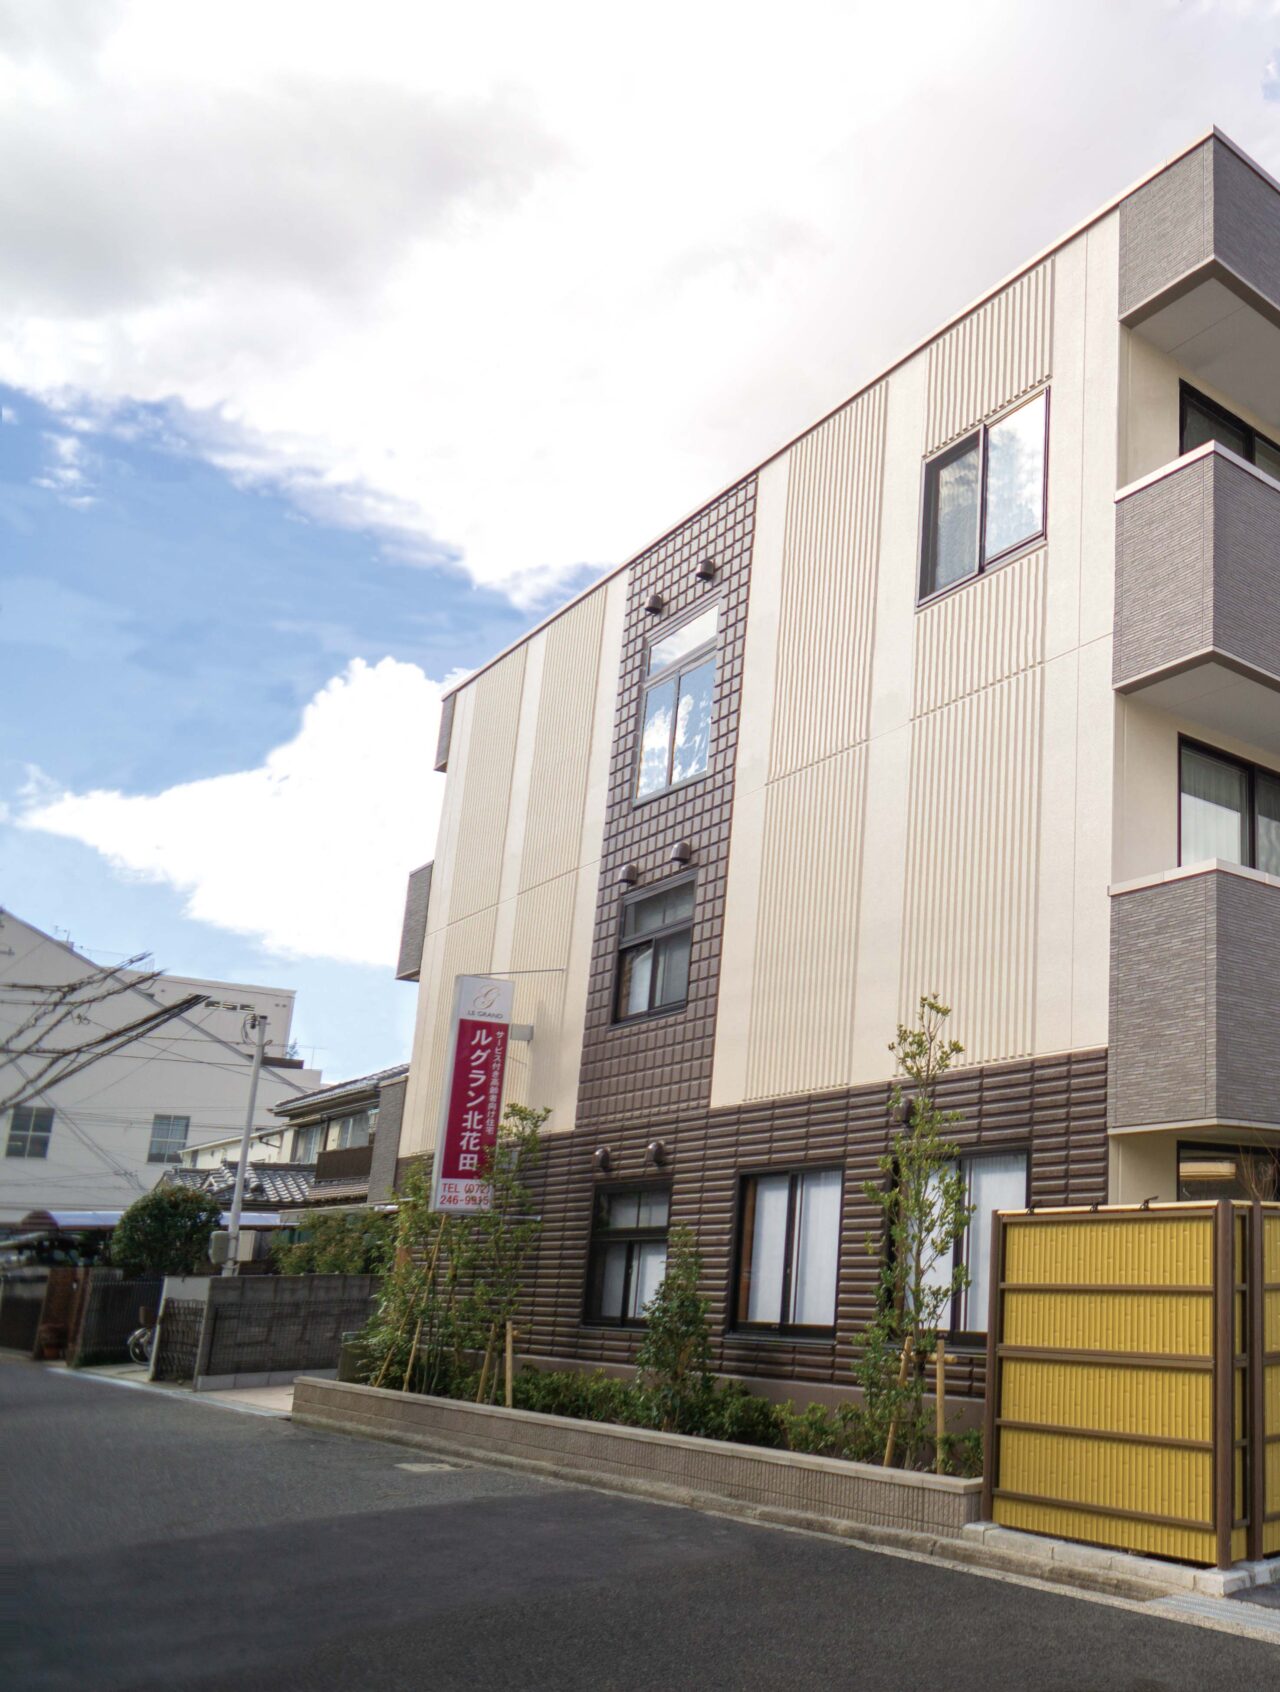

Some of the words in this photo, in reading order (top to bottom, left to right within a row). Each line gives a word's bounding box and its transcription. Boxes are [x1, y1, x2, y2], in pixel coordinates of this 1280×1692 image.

[477, 1010, 504, 1019] GRAND
[458, 1028, 493, 1171] ルグラン北花田
[442, 1183, 459, 1193] TEL
